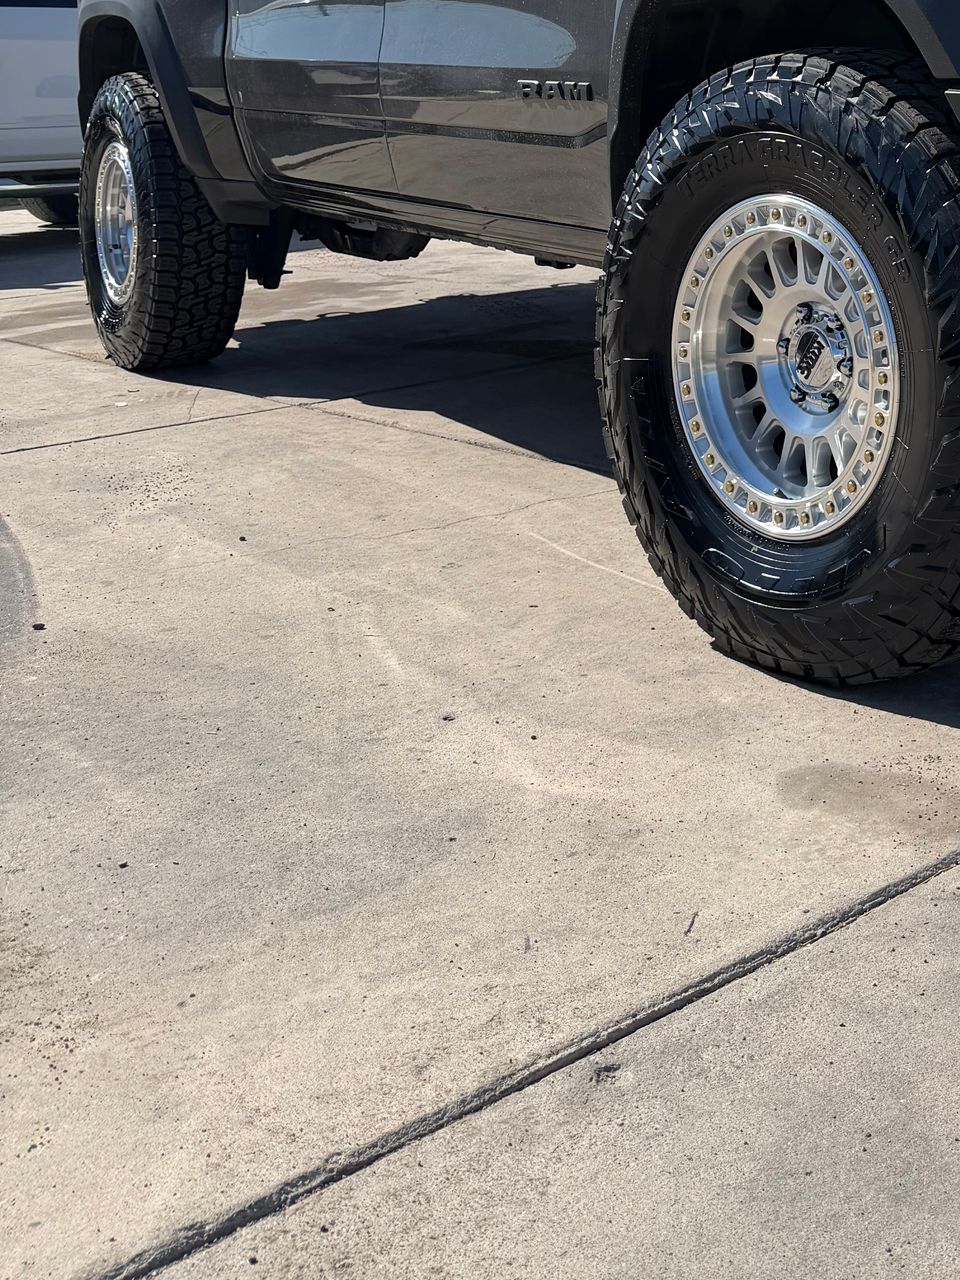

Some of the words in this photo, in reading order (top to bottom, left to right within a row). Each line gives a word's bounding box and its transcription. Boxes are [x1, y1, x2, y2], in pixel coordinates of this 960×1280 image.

[517, 79, 594, 101] RAM
[676, 138, 755, 198] TERRA
[756, 136, 886, 231] GRAPPLER
